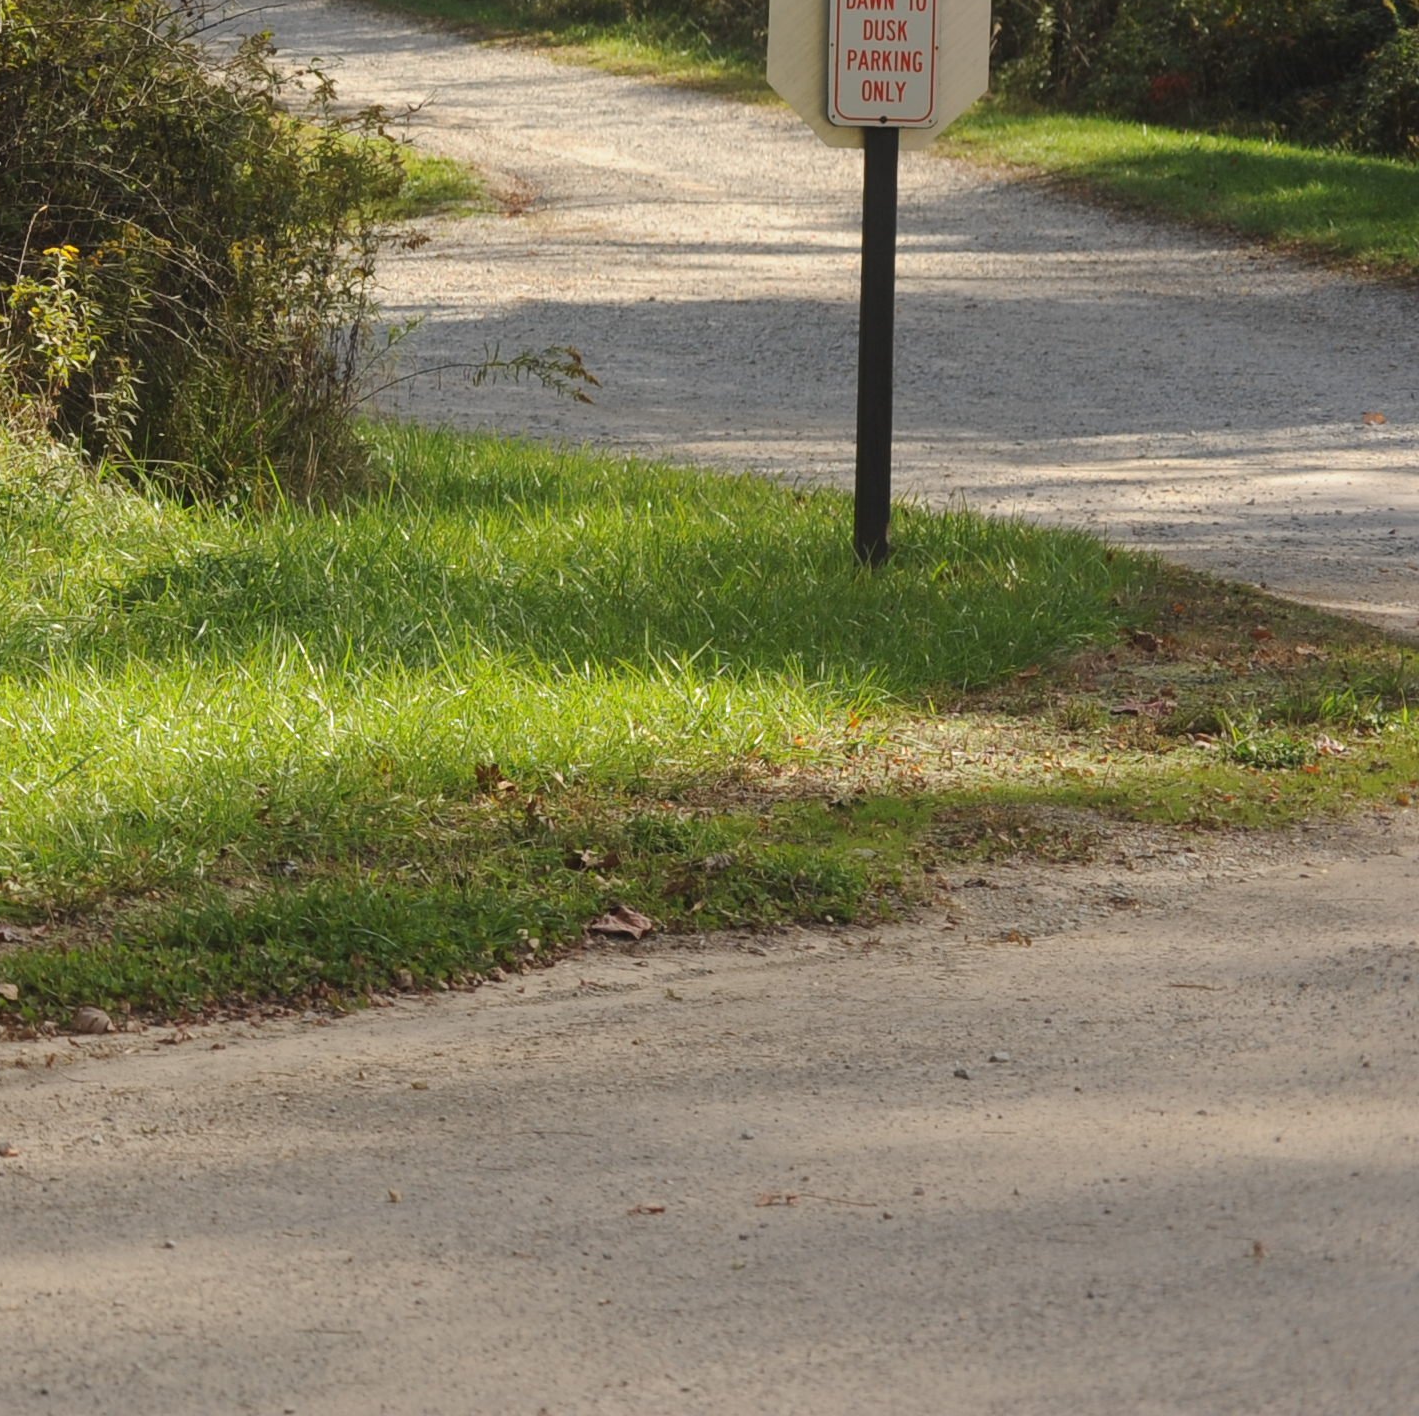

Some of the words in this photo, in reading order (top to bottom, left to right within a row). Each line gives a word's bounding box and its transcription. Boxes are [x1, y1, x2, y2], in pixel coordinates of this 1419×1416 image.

[863, 20, 907, 41] DUSK
[847, 50, 922, 72] PARKING
[862, 80, 906, 102] ONLY
